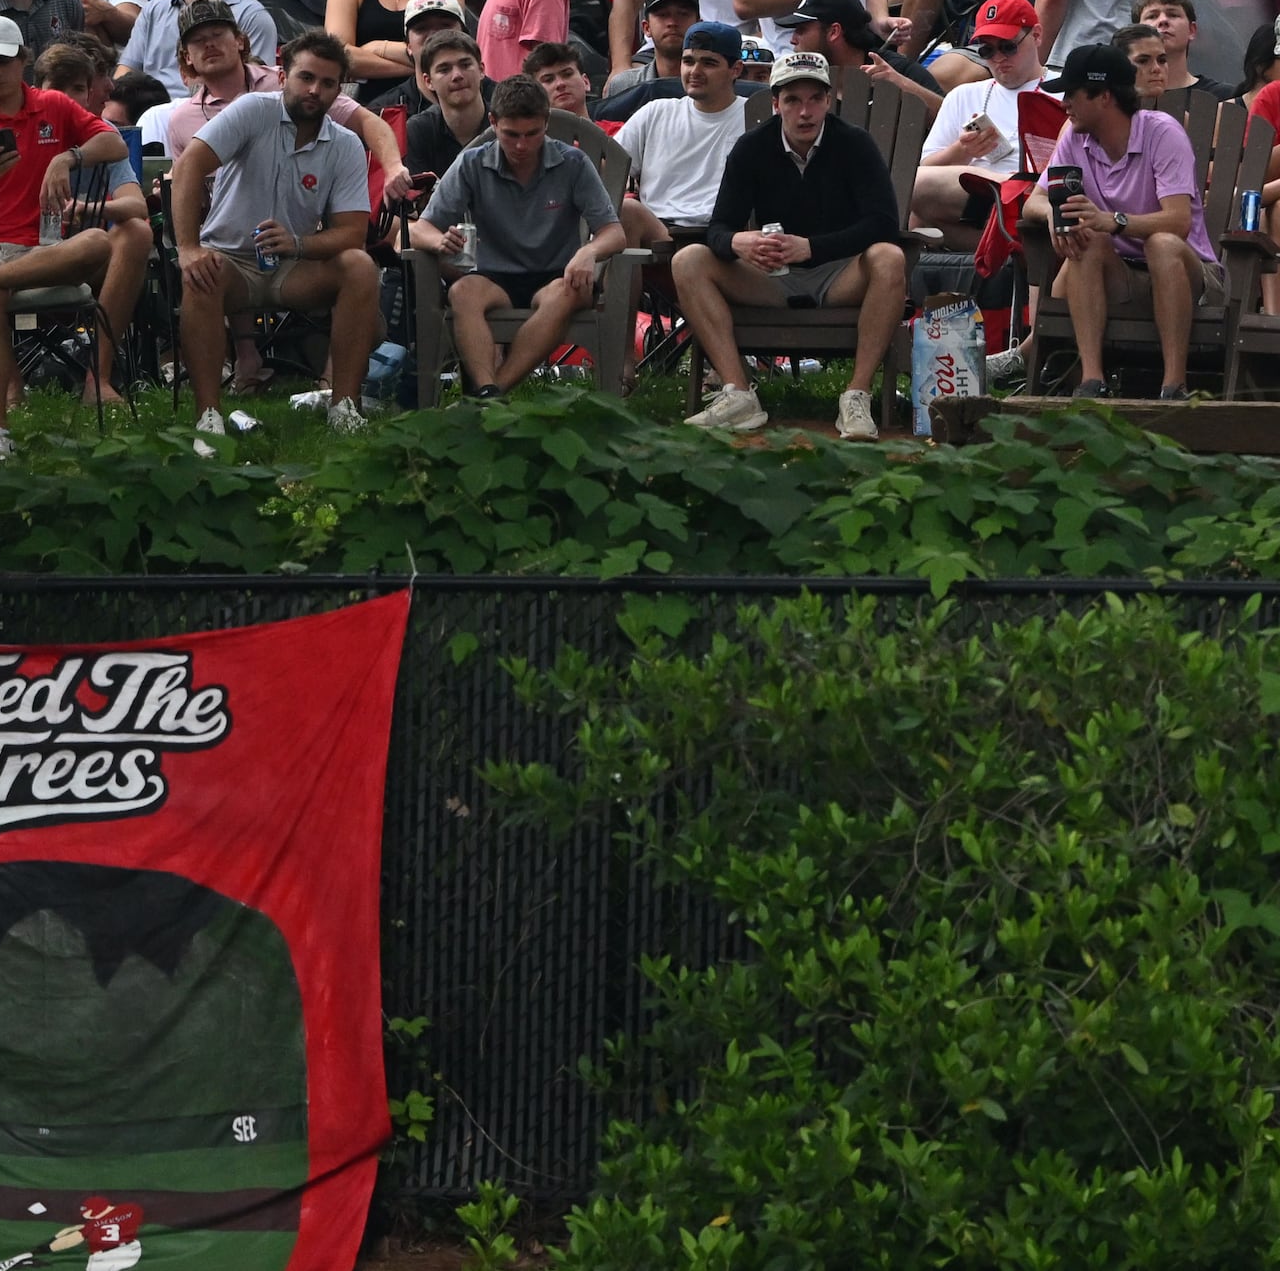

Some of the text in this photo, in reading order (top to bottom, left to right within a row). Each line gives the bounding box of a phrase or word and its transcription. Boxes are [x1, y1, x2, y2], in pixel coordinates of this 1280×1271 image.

[82, 654, 228, 744] The
[232, 1115, 257, 1141] SEC
[93, 1212, 132, 1228] JACKSON
[101, 1224, 120, 1241] 3
